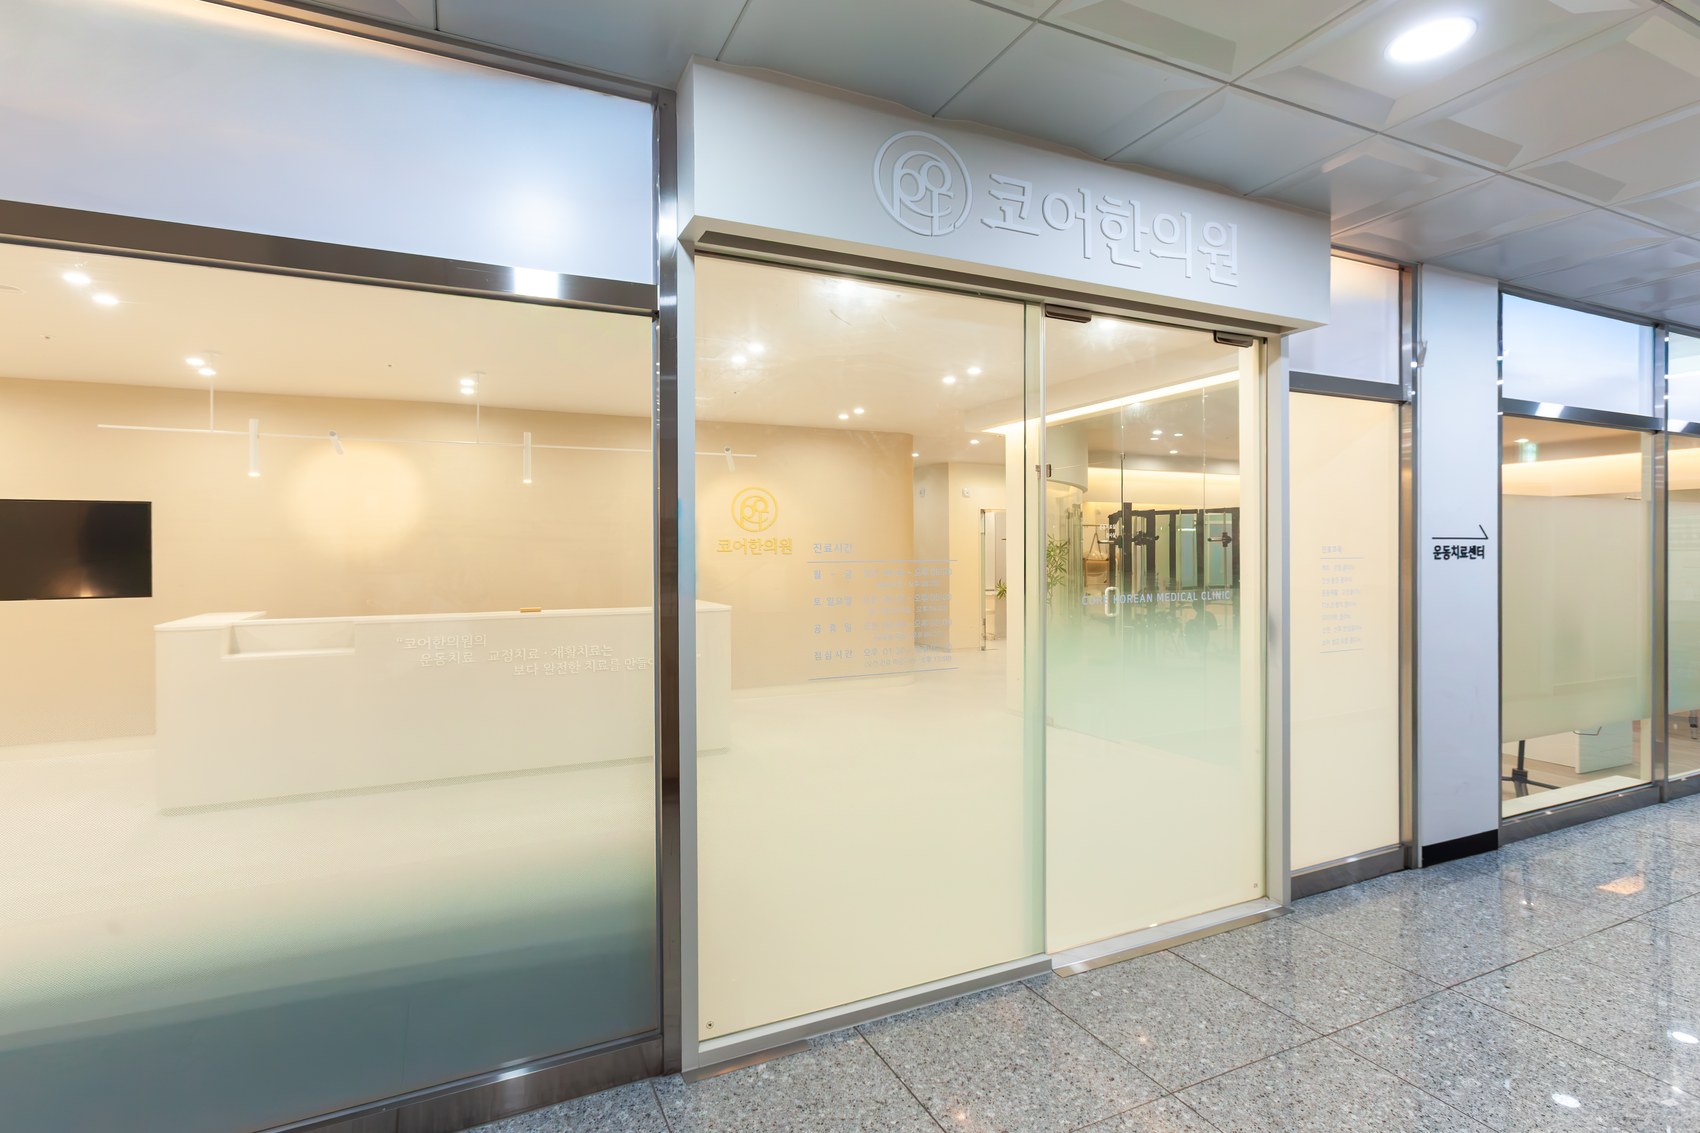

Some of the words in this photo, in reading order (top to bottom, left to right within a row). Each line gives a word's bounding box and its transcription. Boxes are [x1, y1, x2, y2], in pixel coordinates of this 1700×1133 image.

[980, 173, 1240, 287] 코어한의원
[717, 537, 793, 555] 코어한의원
[1433, 545, 1485, 561] 운동치료센터
[1157, 591, 1198, 602] MEDICAL
[1201, 590, 1231, 601] CLINIC
[418, 651, 475, 667] 운동치료
[487, 648, 540, 663] 교정치료
[512, 662, 539, 677] 보다
[543, 660, 581, 676] 완전한
